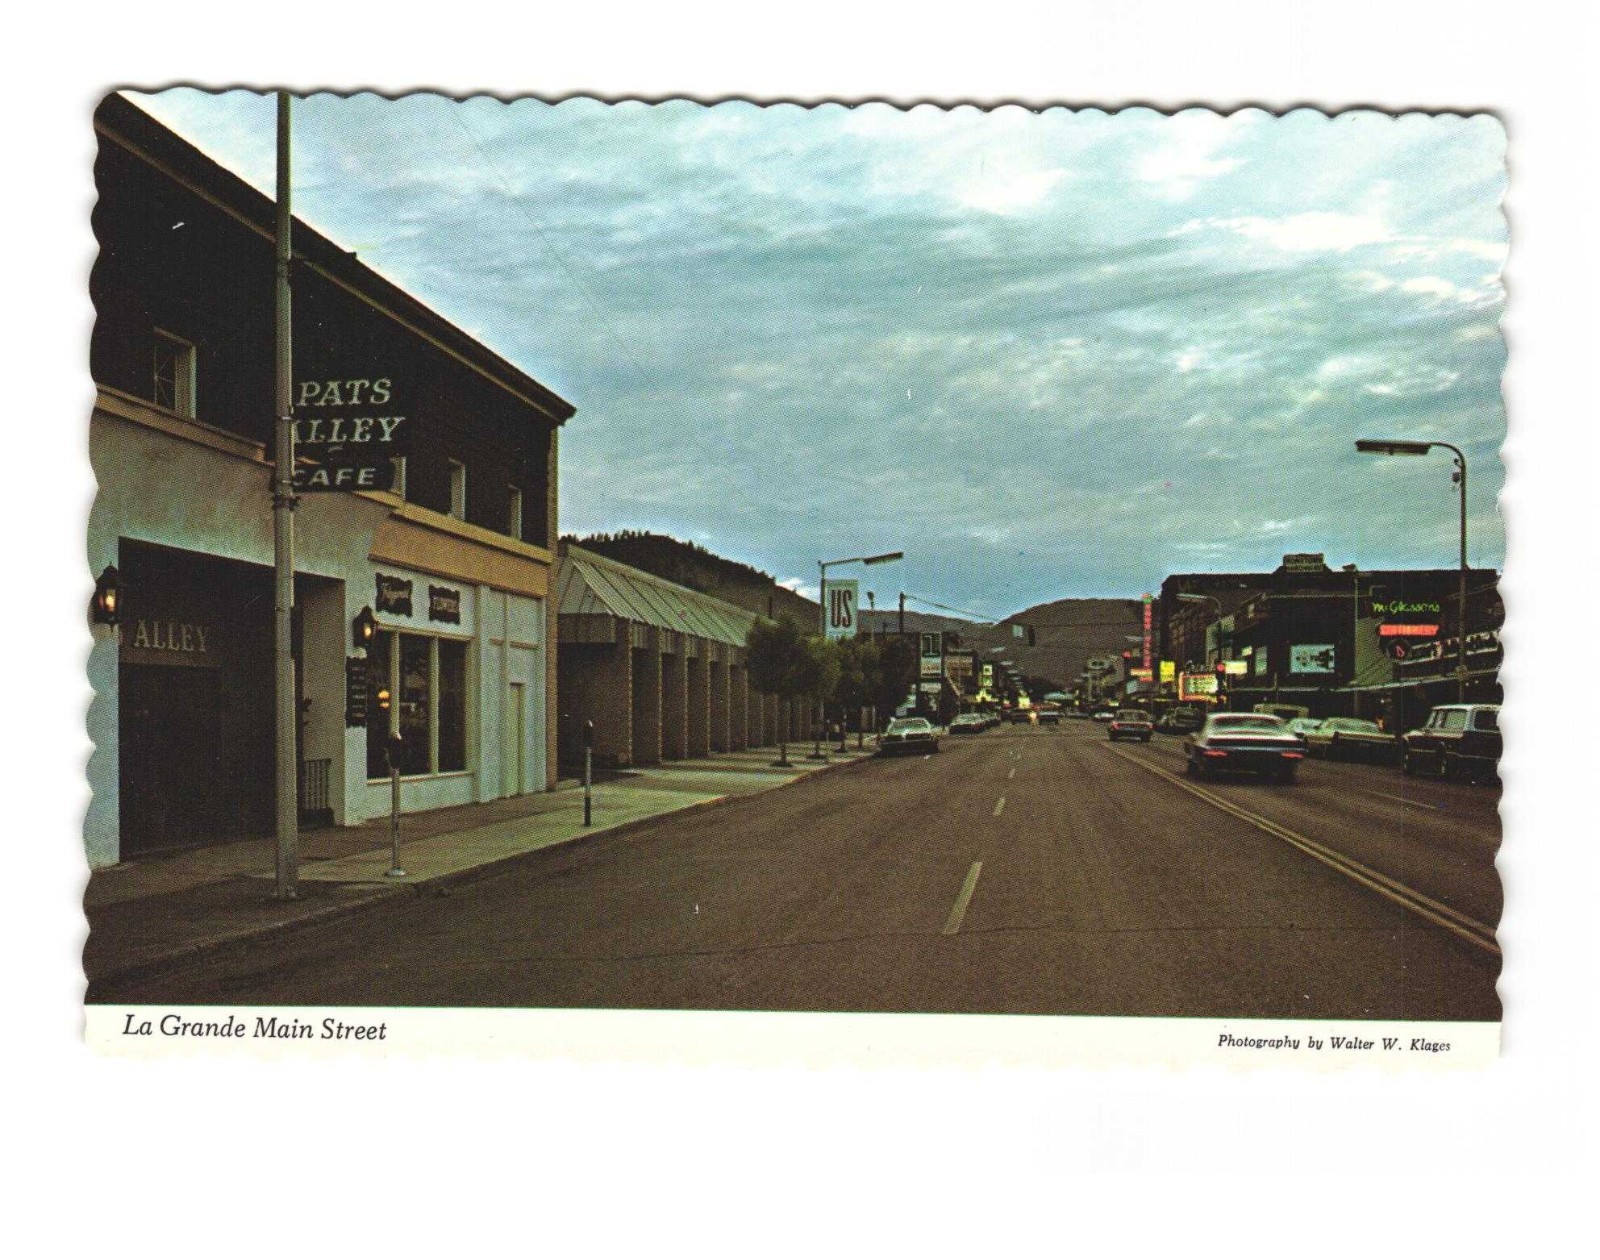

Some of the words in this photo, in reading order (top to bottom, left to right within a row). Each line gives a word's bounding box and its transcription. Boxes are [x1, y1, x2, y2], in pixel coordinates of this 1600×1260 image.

[296, 377, 392, 407] PATS
[292, 467, 377, 487] CAFE
[831, 589, 853, 628] US
[133, 618, 208, 652] ALLEY
